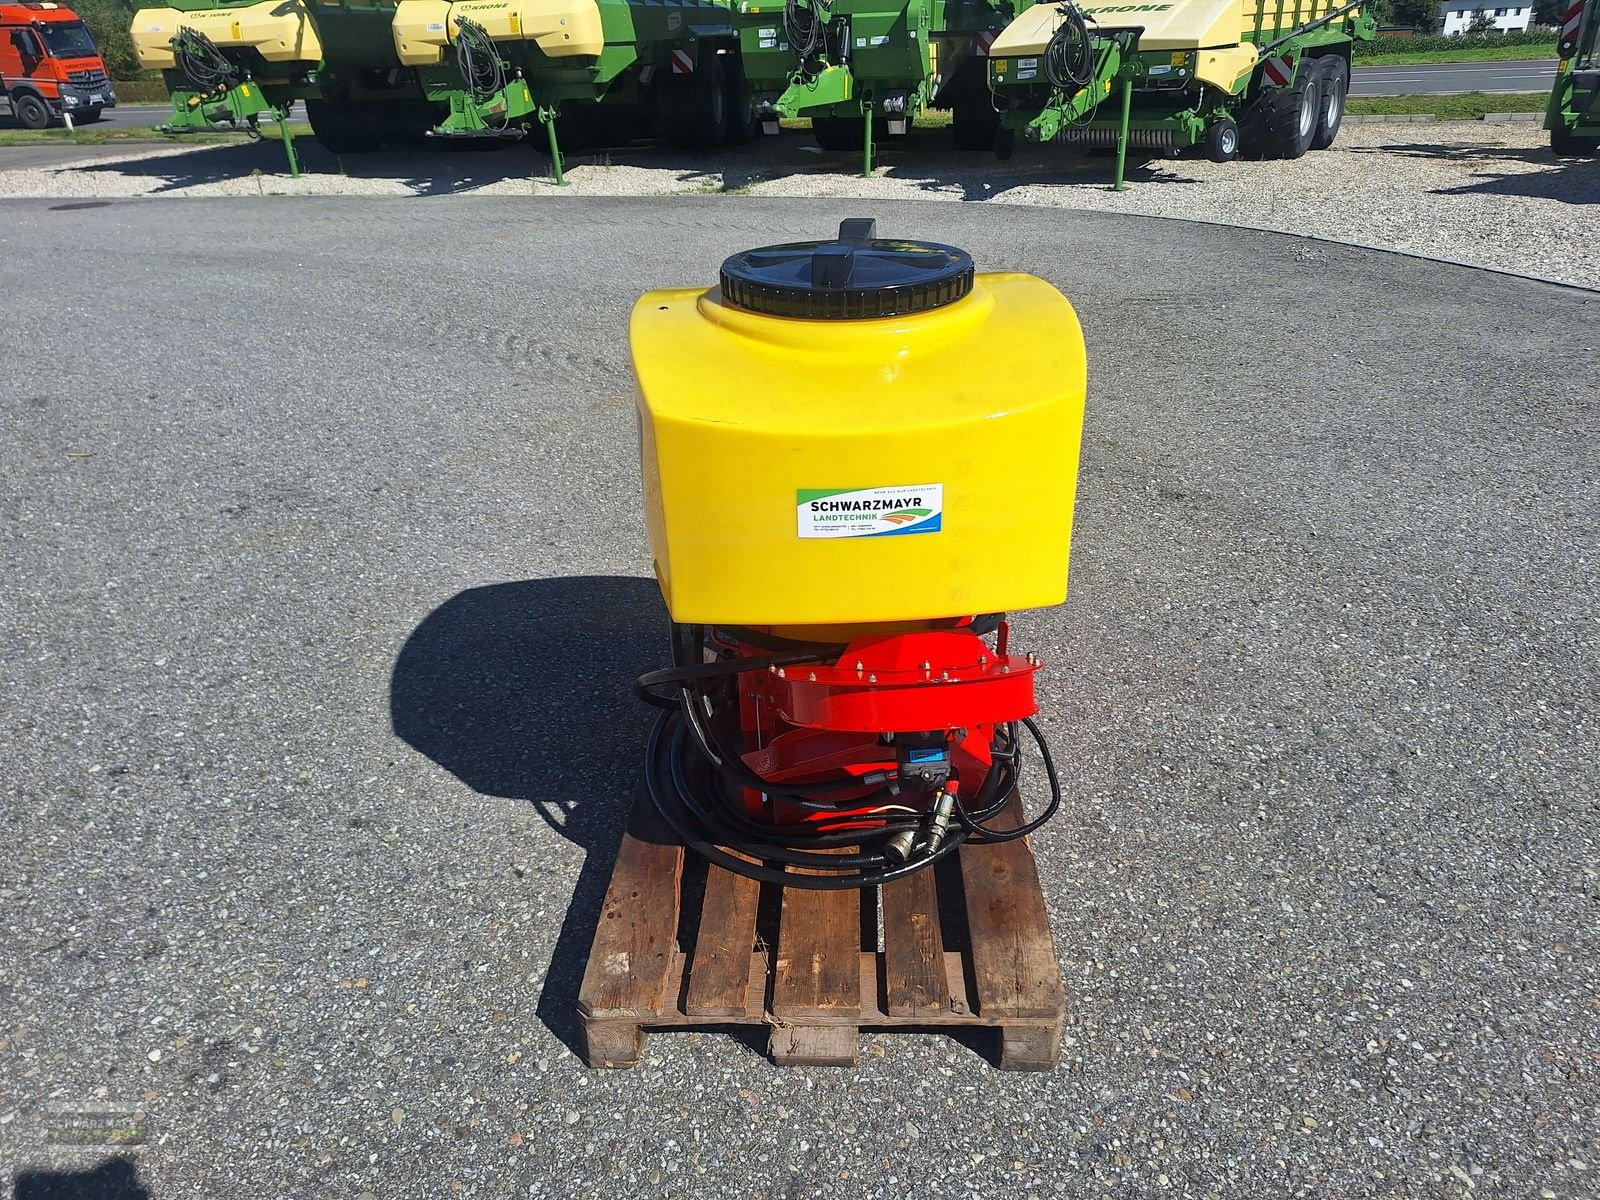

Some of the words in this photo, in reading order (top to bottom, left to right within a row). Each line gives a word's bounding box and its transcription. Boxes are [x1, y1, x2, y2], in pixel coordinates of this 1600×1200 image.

[1082, 4, 1175, 15] KRONE
[811, 497, 922, 512] SCHWARZMAYR
[813, 513, 878, 522] LANDTECHNIK
